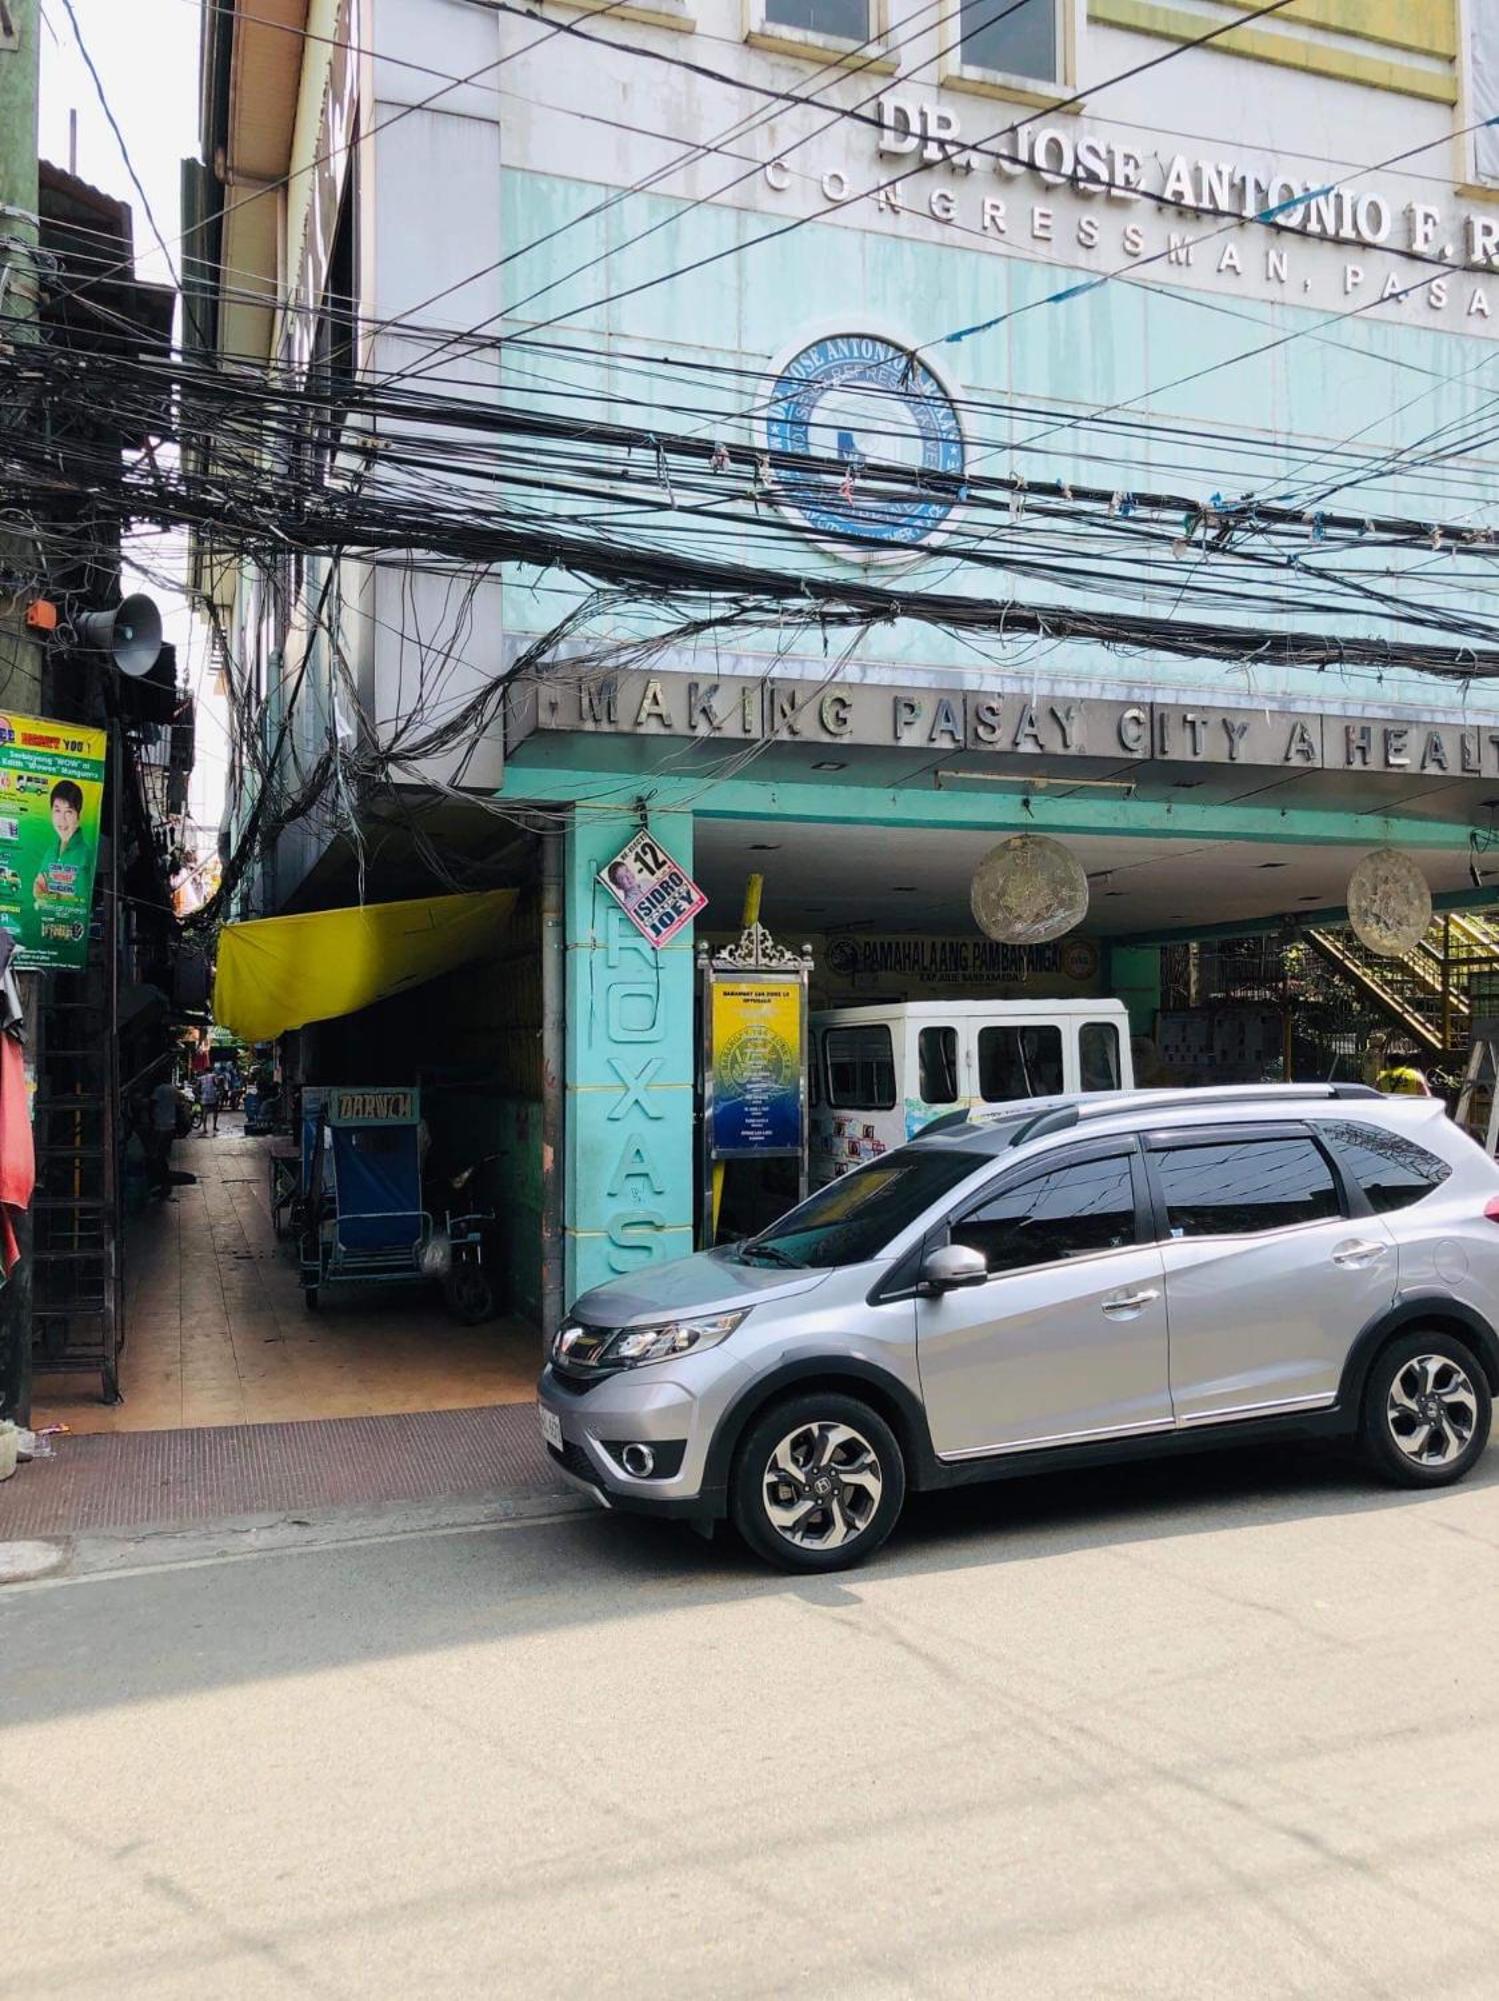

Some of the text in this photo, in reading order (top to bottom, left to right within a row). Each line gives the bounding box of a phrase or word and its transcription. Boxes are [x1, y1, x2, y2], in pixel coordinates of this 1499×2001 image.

[766, 159, 1492, 319] CONGRESSMAN, PASA
[877, 95, 980, 171] DR.
[998, 123, 1147, 201] JOSE
[1163, 153, 1391, 243] ANTONIO
[579, 678, 854, 737] MAKING
[895, 693, 1074, 751] PASAY
[1117, 708, 1249, 760] CITY
[1285, 714, 1315, 762] A
[633, 872, 684, 921] ISIDRO
[607, 906, 665, 1274] ROXAS
